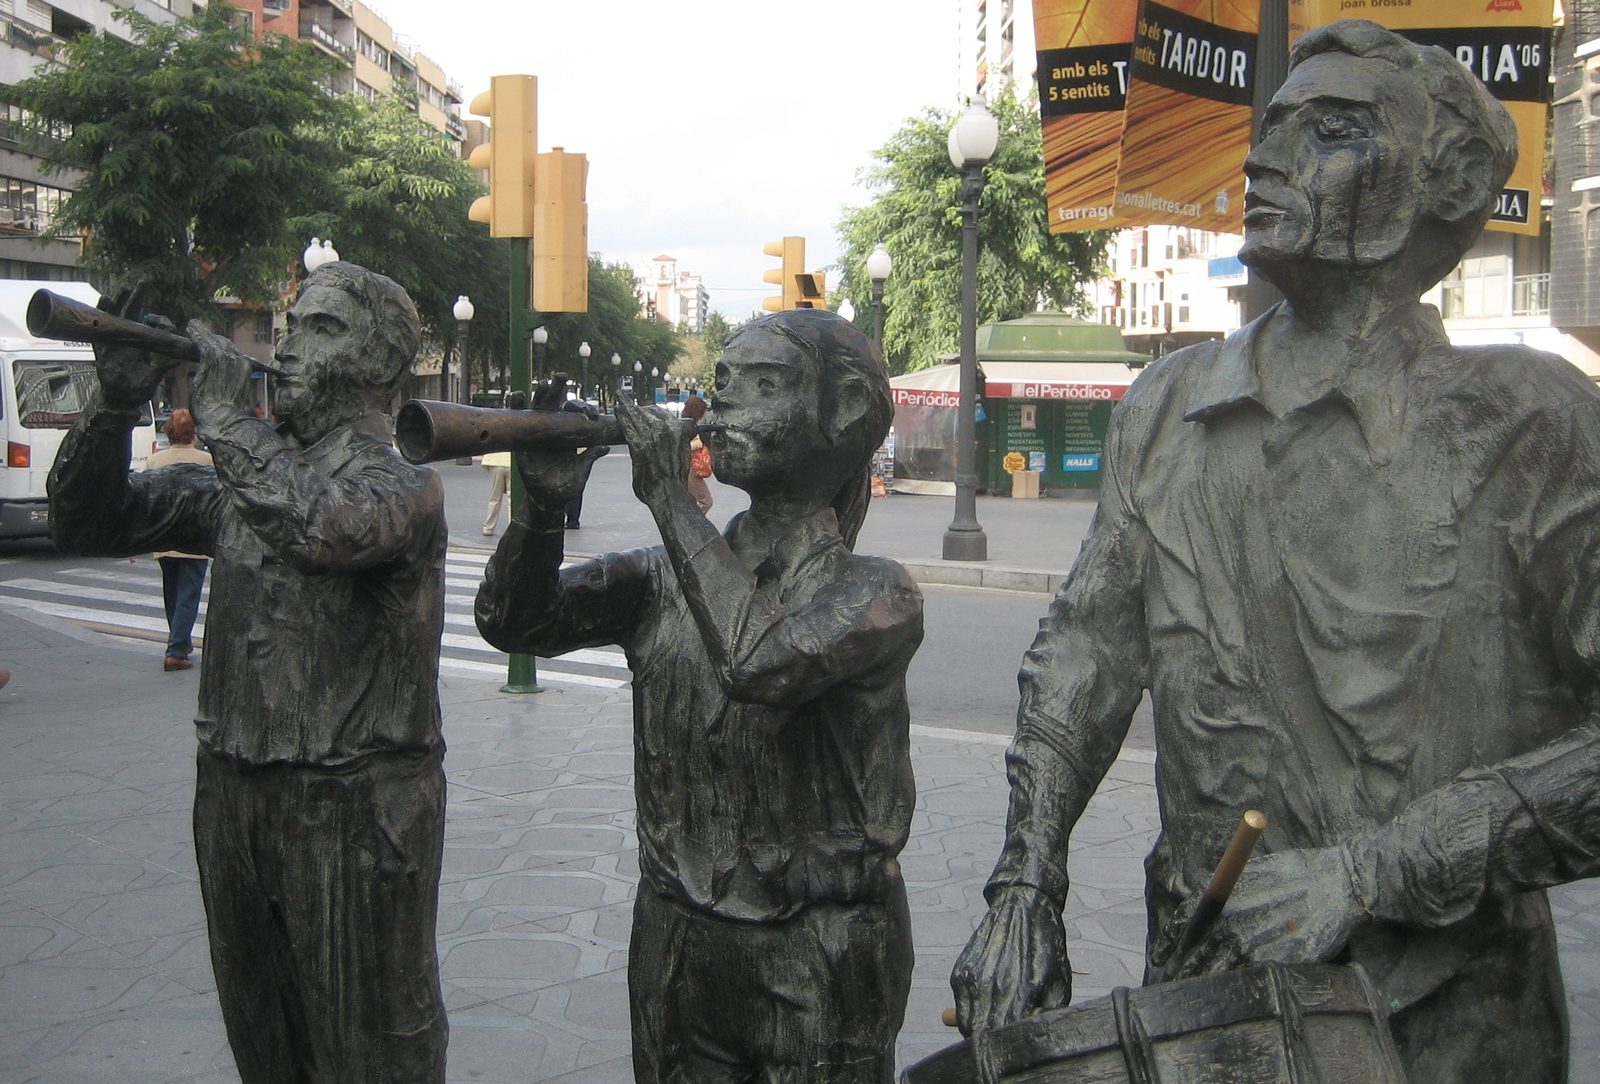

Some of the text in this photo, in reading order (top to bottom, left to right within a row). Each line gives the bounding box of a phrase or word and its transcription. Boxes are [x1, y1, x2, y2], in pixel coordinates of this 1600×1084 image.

[1148, 22, 1161, 41] els
[1161, 28, 1247, 88] TARDOR
[1456, 44, 1518, 82] RIA
[1052, 60, 1108, 79] amb els
[1112, 61, 1127, 95] T
[1049, 82, 1110, 101] 5 sentits
[1025, 383, 1111, 399] el Periódico
[1066, 458, 1094, 467] HALLS
